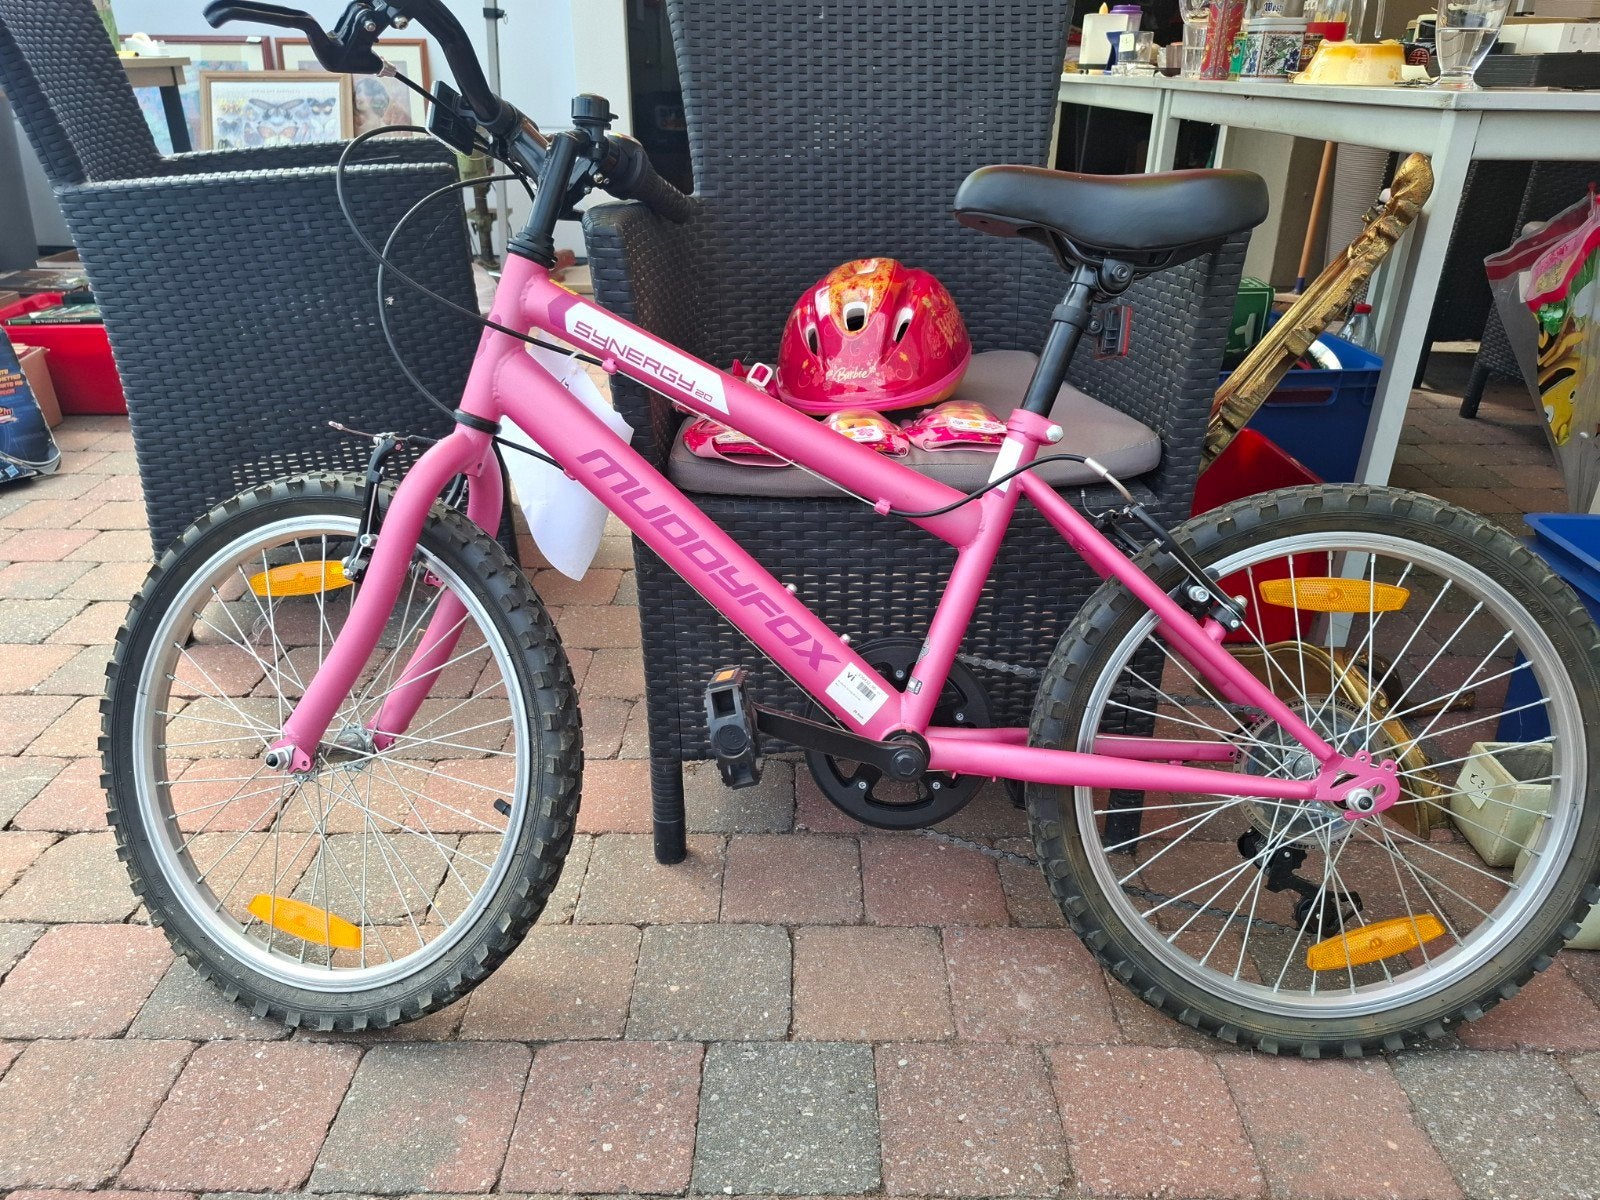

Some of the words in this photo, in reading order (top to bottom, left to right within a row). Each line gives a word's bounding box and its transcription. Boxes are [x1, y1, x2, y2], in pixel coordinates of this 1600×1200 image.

[572, 320, 697, 394] SYNERGY
[695, 389, 714, 404] 20
[832, 366, 870, 382] Barbie
[576, 449, 840, 672] MUDDYFOX
